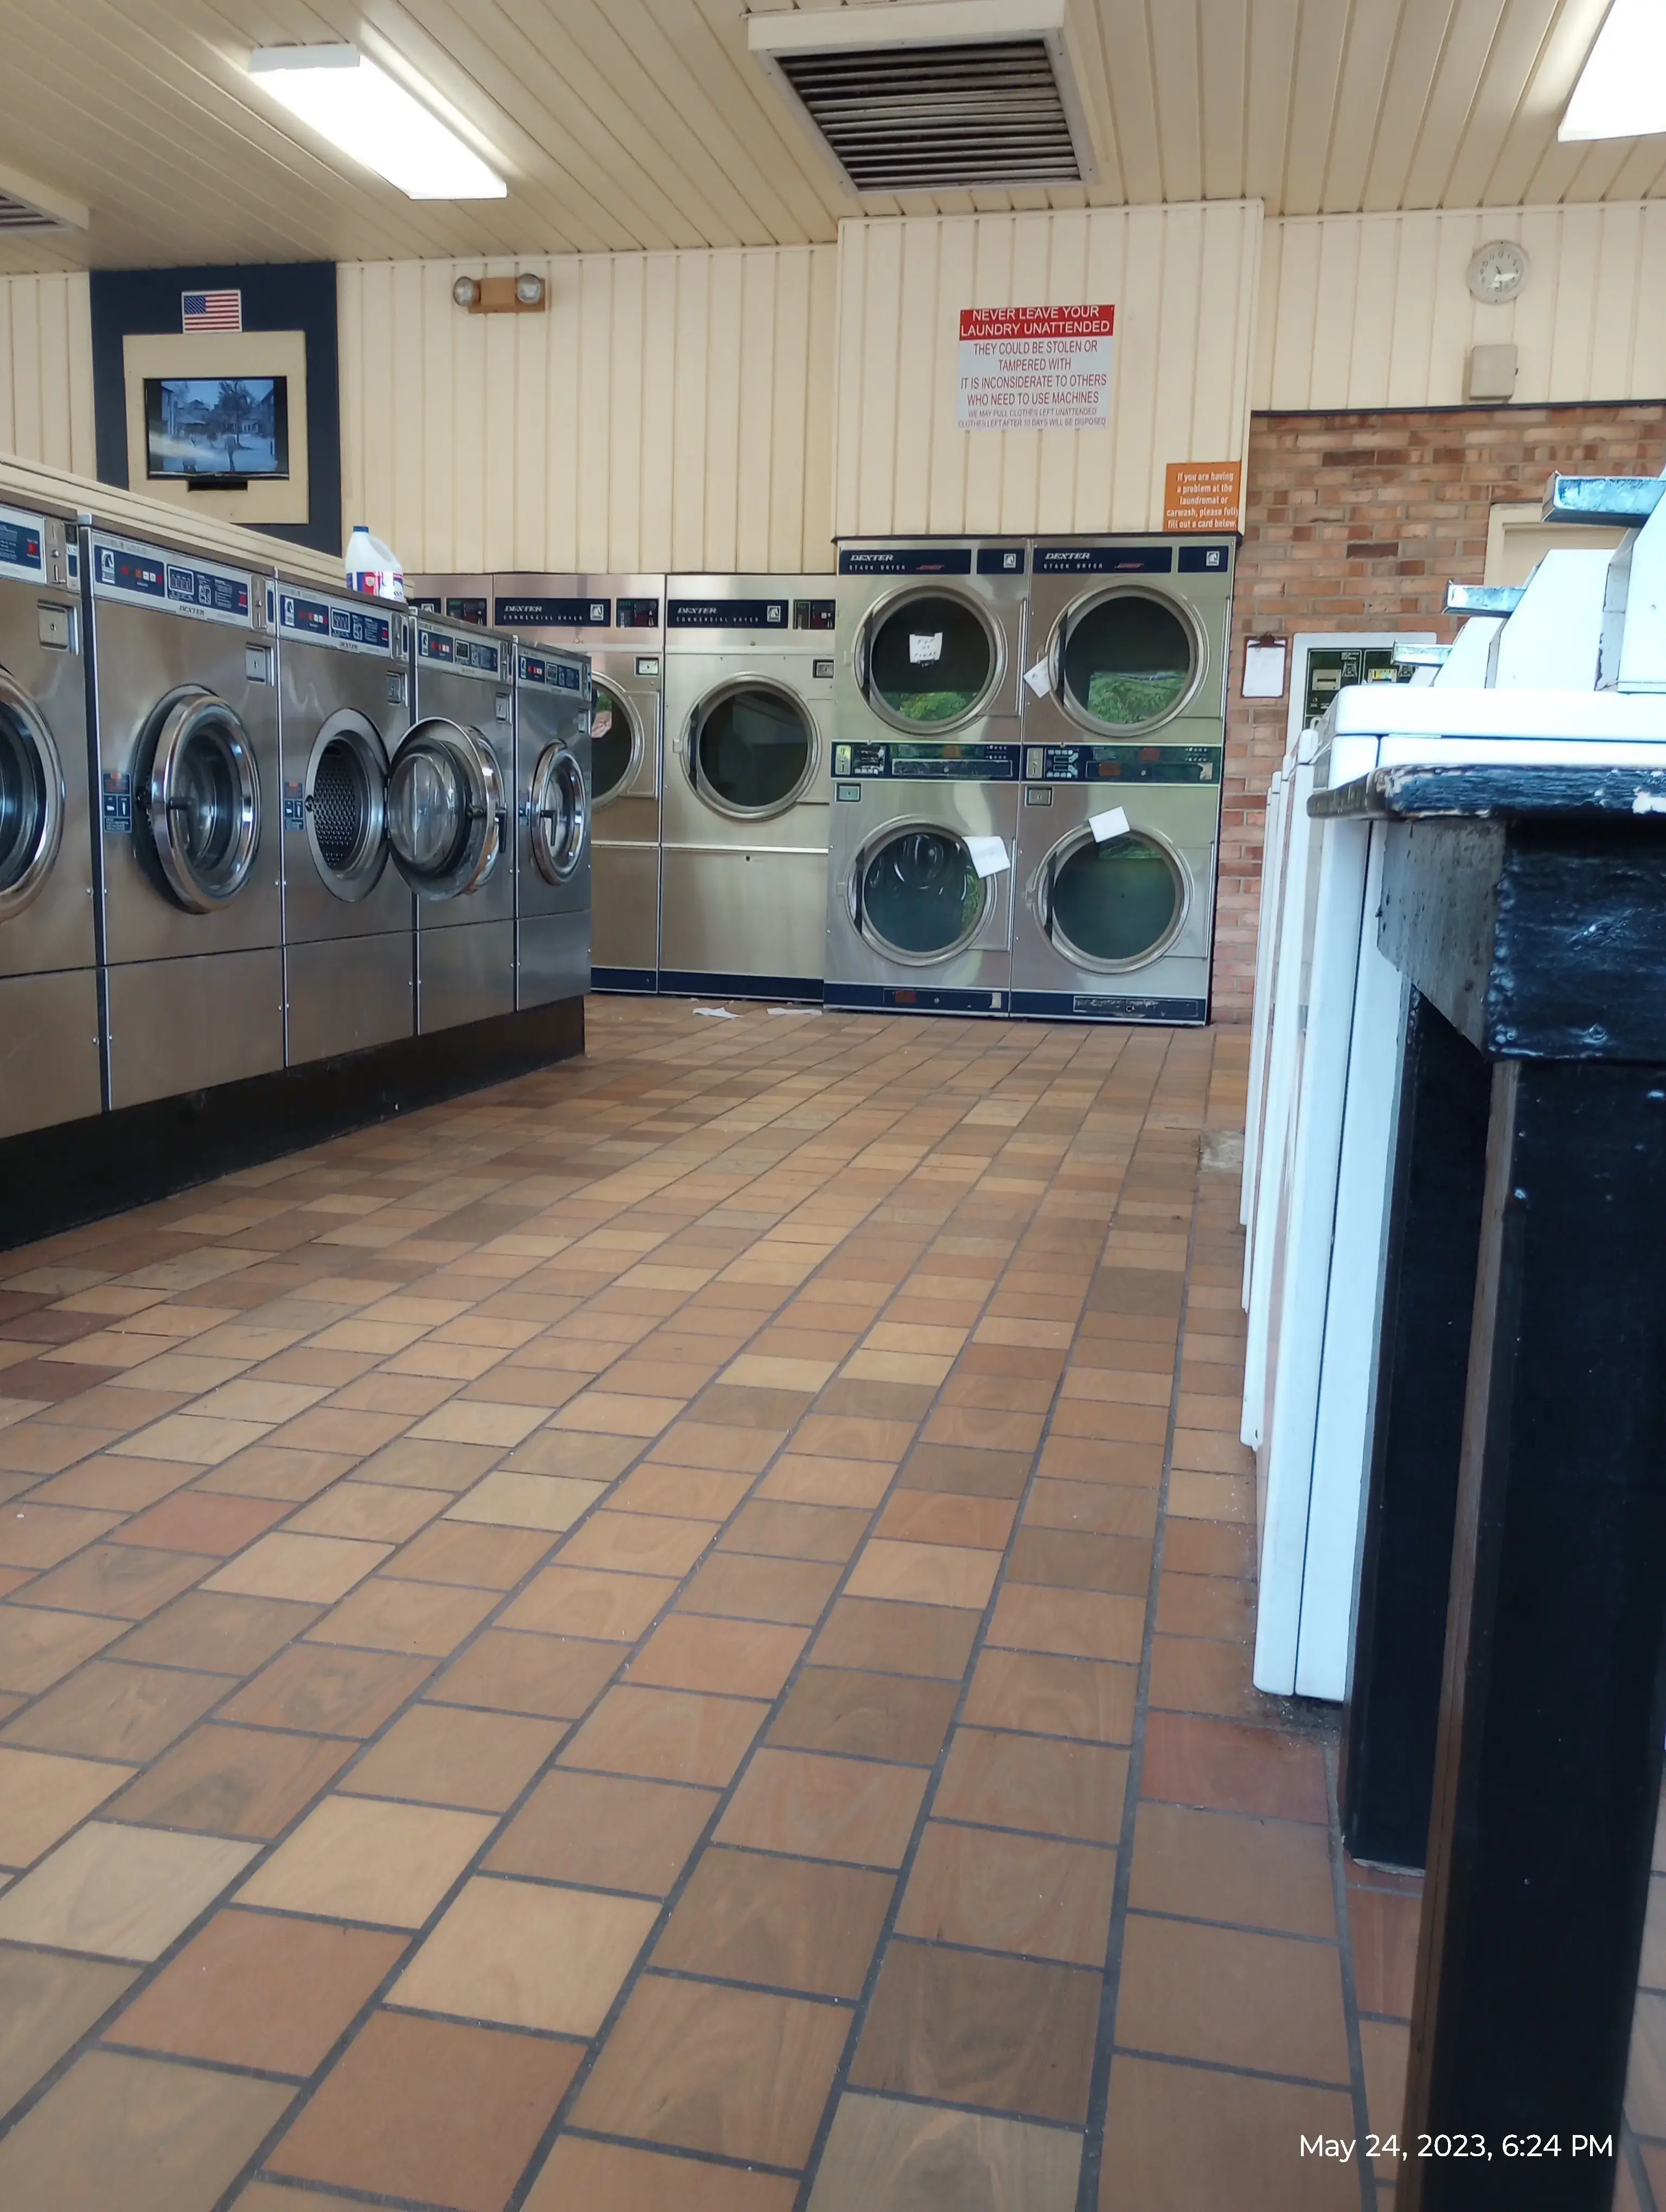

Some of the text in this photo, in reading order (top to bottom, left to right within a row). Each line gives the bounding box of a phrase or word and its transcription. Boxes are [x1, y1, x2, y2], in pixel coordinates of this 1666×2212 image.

[973, 306, 1099, 321] NEVER LEAVE YOUR
[961, 320, 1110, 337] LAUNDRY UNATTENDED
[974, 339, 1097, 355] THEY COULD BE STOLEN OR
[998, 358, 1071, 371] TAMPERED WITH
[961, 374, 1107, 389] IT IS INCONSIDERATE TO OTHERS
[967, 391, 1099, 406] WHO NEED TO USE MACHINES
[968, 409, 977, 418] WE
[993, 409, 1008, 417] PULL
[1009, 408, 1038, 416] CLOTHES
[958, 420, 986, 428] CLOTHES
[987, 419, 1002, 427] LEFT
[1003, 419, 1022, 427] AFTER
[1031, 419, 1048, 427] DAYS
[1177, 472, 1183, 481] If
[1184, 473, 1197, 483] you
[1210, 471, 1234, 482] having
[1182, 484, 1211, 495] problem
[1212, 484, 1220, 492] at
[1221, 484, 1233, 492] the
[1179, 496, 1228, 505] laundromat or
[1167, 506, 1238, 518] carwash, please fully
[1167, 519, 1178, 529] fill
[1179, 519, 1190, 528] out
[1197, 519, 1213, 528] card
[1214, 518, 1237, 528] below.
